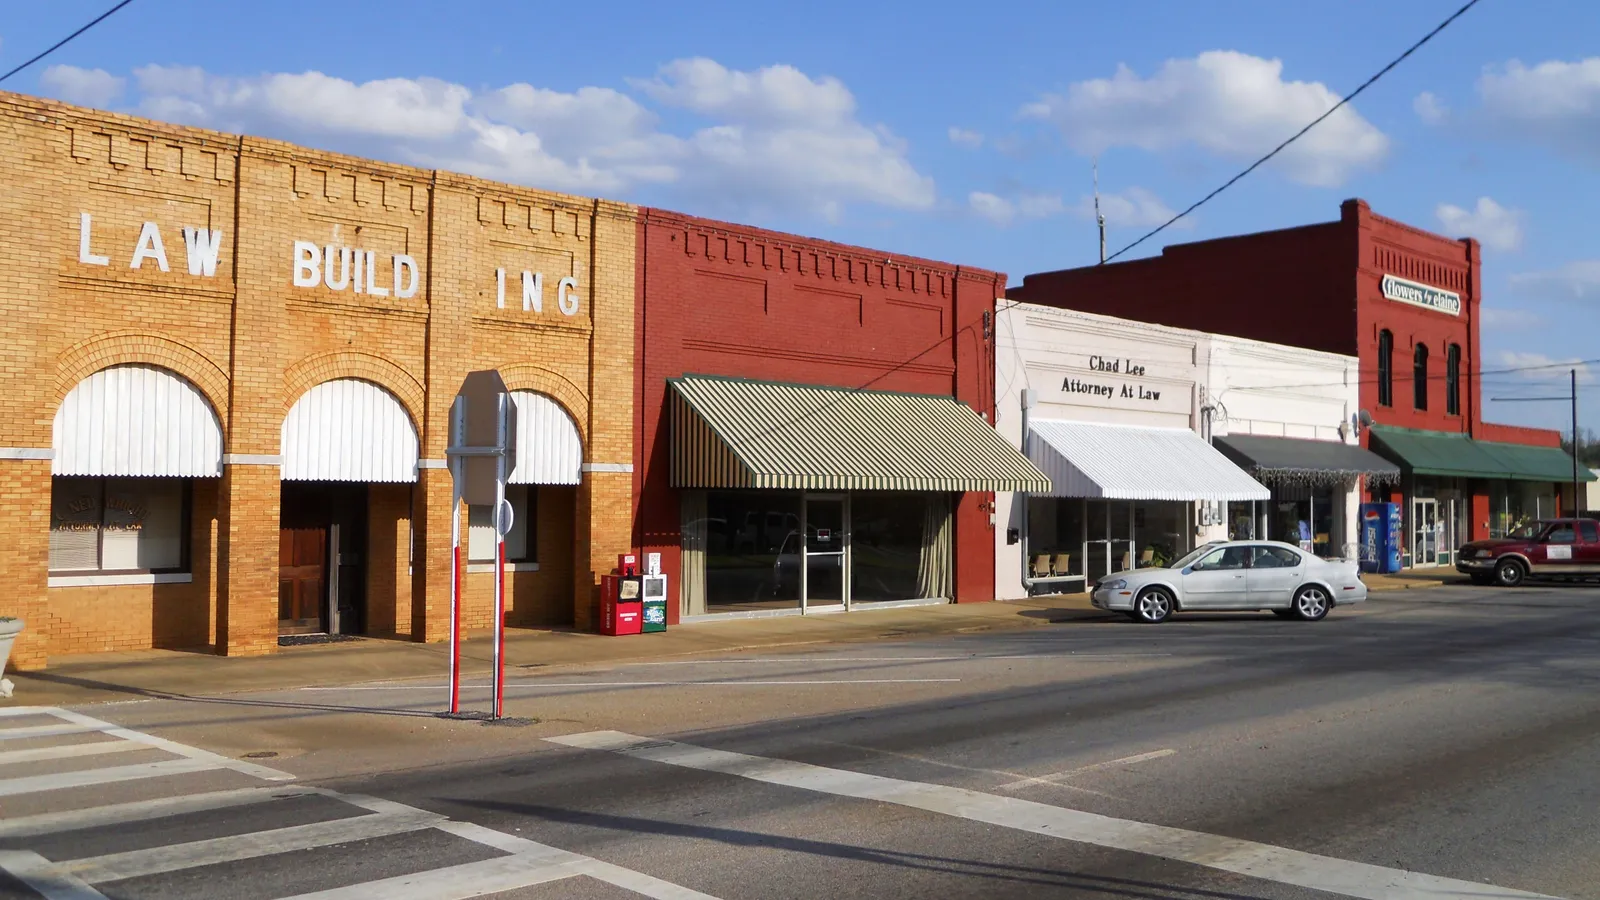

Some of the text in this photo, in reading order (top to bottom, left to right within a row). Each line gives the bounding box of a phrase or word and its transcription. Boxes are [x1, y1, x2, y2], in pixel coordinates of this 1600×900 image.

[80, 212, 579, 316] LAW BUILD ING
[1387, 281, 1422, 303] flowers
[1433, 292, 1458, 311] elaine
[1089, 355, 1146, 376] Chad Lee
[1061, 377, 1161, 401] Attorney At Law
[1367, 527, 1376, 562] PEPSI
